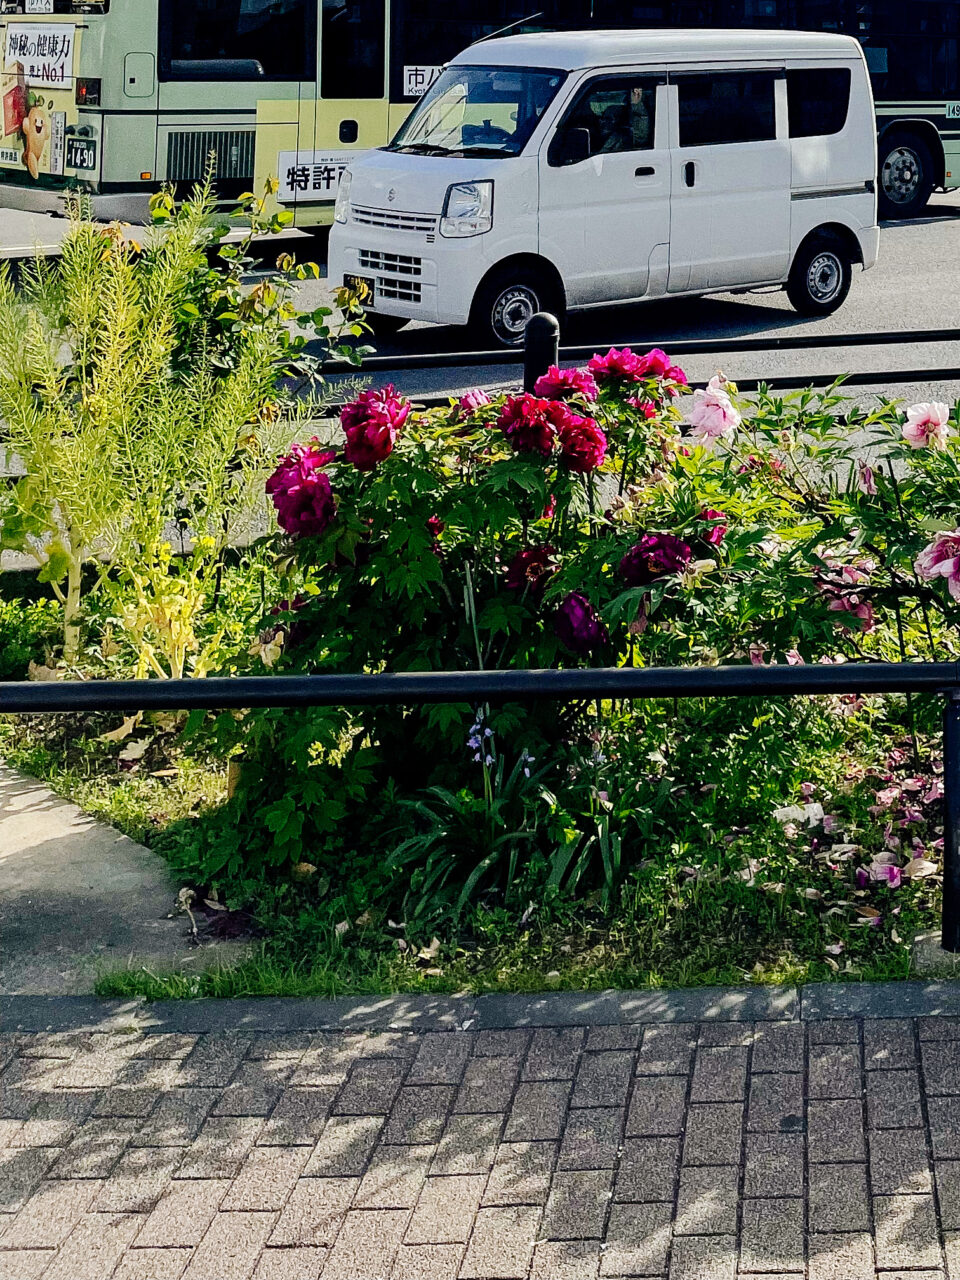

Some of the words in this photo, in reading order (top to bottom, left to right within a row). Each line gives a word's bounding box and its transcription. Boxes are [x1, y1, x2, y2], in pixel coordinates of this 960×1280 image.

[9, 33, 70, 64] 神秘の健康力
[42, 62, 65, 82] No.1
